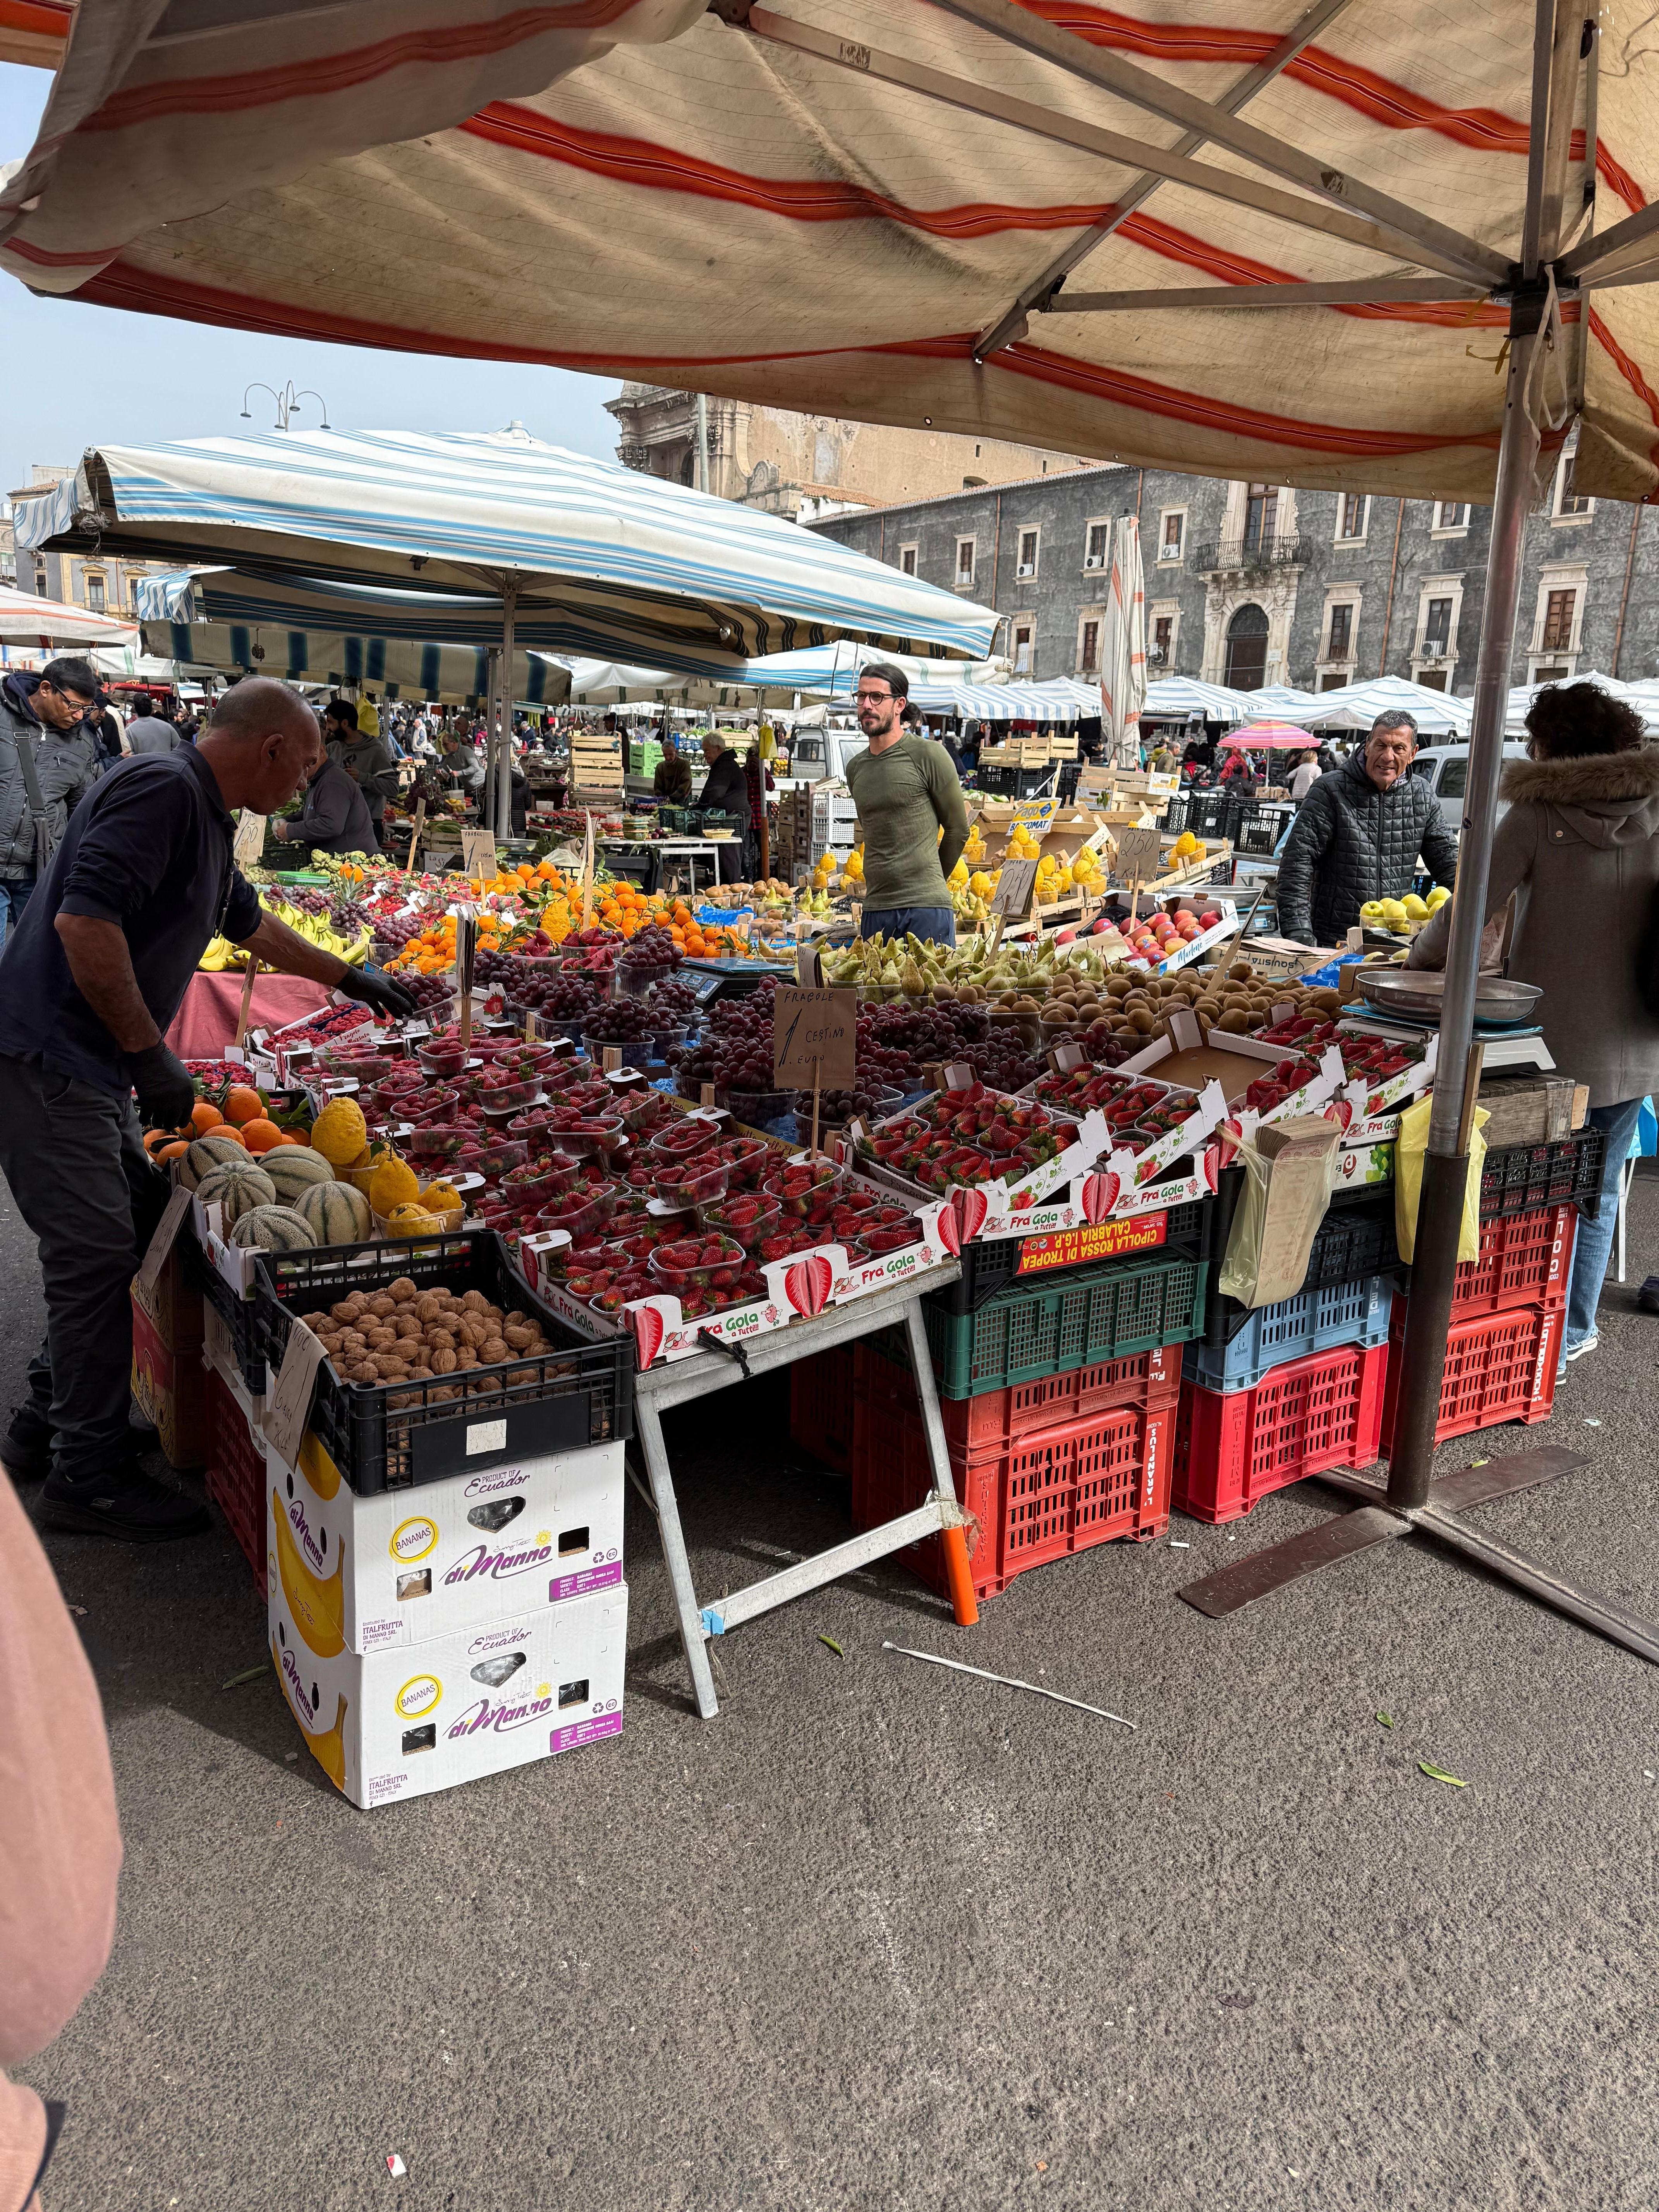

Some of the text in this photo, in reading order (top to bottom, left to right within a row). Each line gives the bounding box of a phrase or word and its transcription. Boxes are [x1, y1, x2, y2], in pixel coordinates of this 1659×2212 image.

[1121, 832, 1154, 857] 250
[1161, 1184, 1183, 1197] Gola
[1032, 1212, 1058, 1225] Gola
[1082, 1221, 1131, 1243] CALABRIA
[1023, 1230, 1157, 1270] CIPOLLA ROSSA DI TROPEA
[887, 1255, 915, 1273] Gola
[726, 1313, 759, 1331] Gola
[464, 1470, 530, 1497] Ecuador
[482, 1472, 507, 1484] PRODUCT
[395, 1527, 431, 1550] BANANAS
[363, 1620, 403, 1634] ITALFRUTTA
[486, 1630, 510, 1642] PRODUCT
[468, 1628, 532, 1654] Ecuador
[401, 1684, 435, 1707] BANANAS
[369, 1774, 407, 1790] ITALFRUTTA
